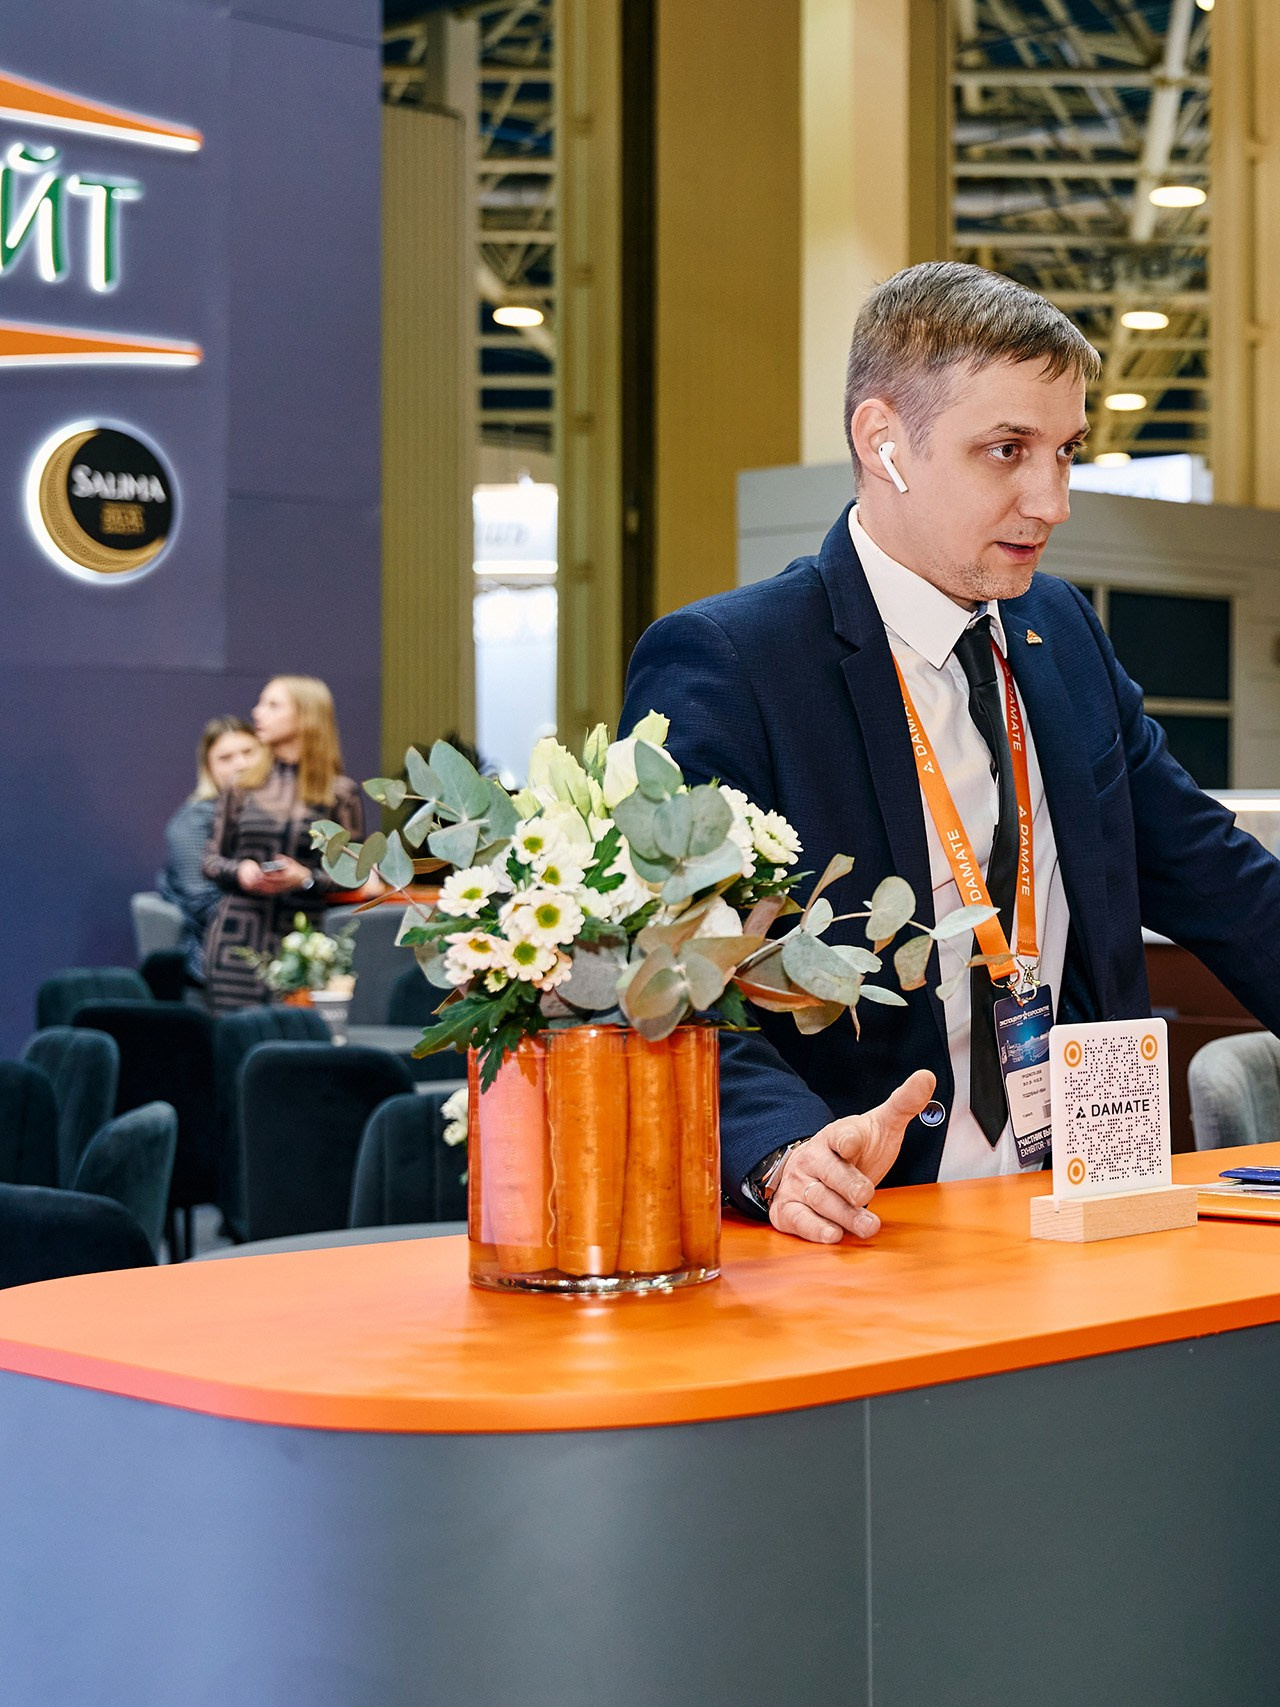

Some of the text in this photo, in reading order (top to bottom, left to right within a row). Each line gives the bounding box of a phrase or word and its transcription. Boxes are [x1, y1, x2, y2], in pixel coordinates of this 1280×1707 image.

[1008, 683, 1022, 752] DAMATE
[947, 829, 983, 902] DAMATE
[1020, 824, 1030, 896] DAMATE
[1091, 1099, 1150, 1117] DAMATE
